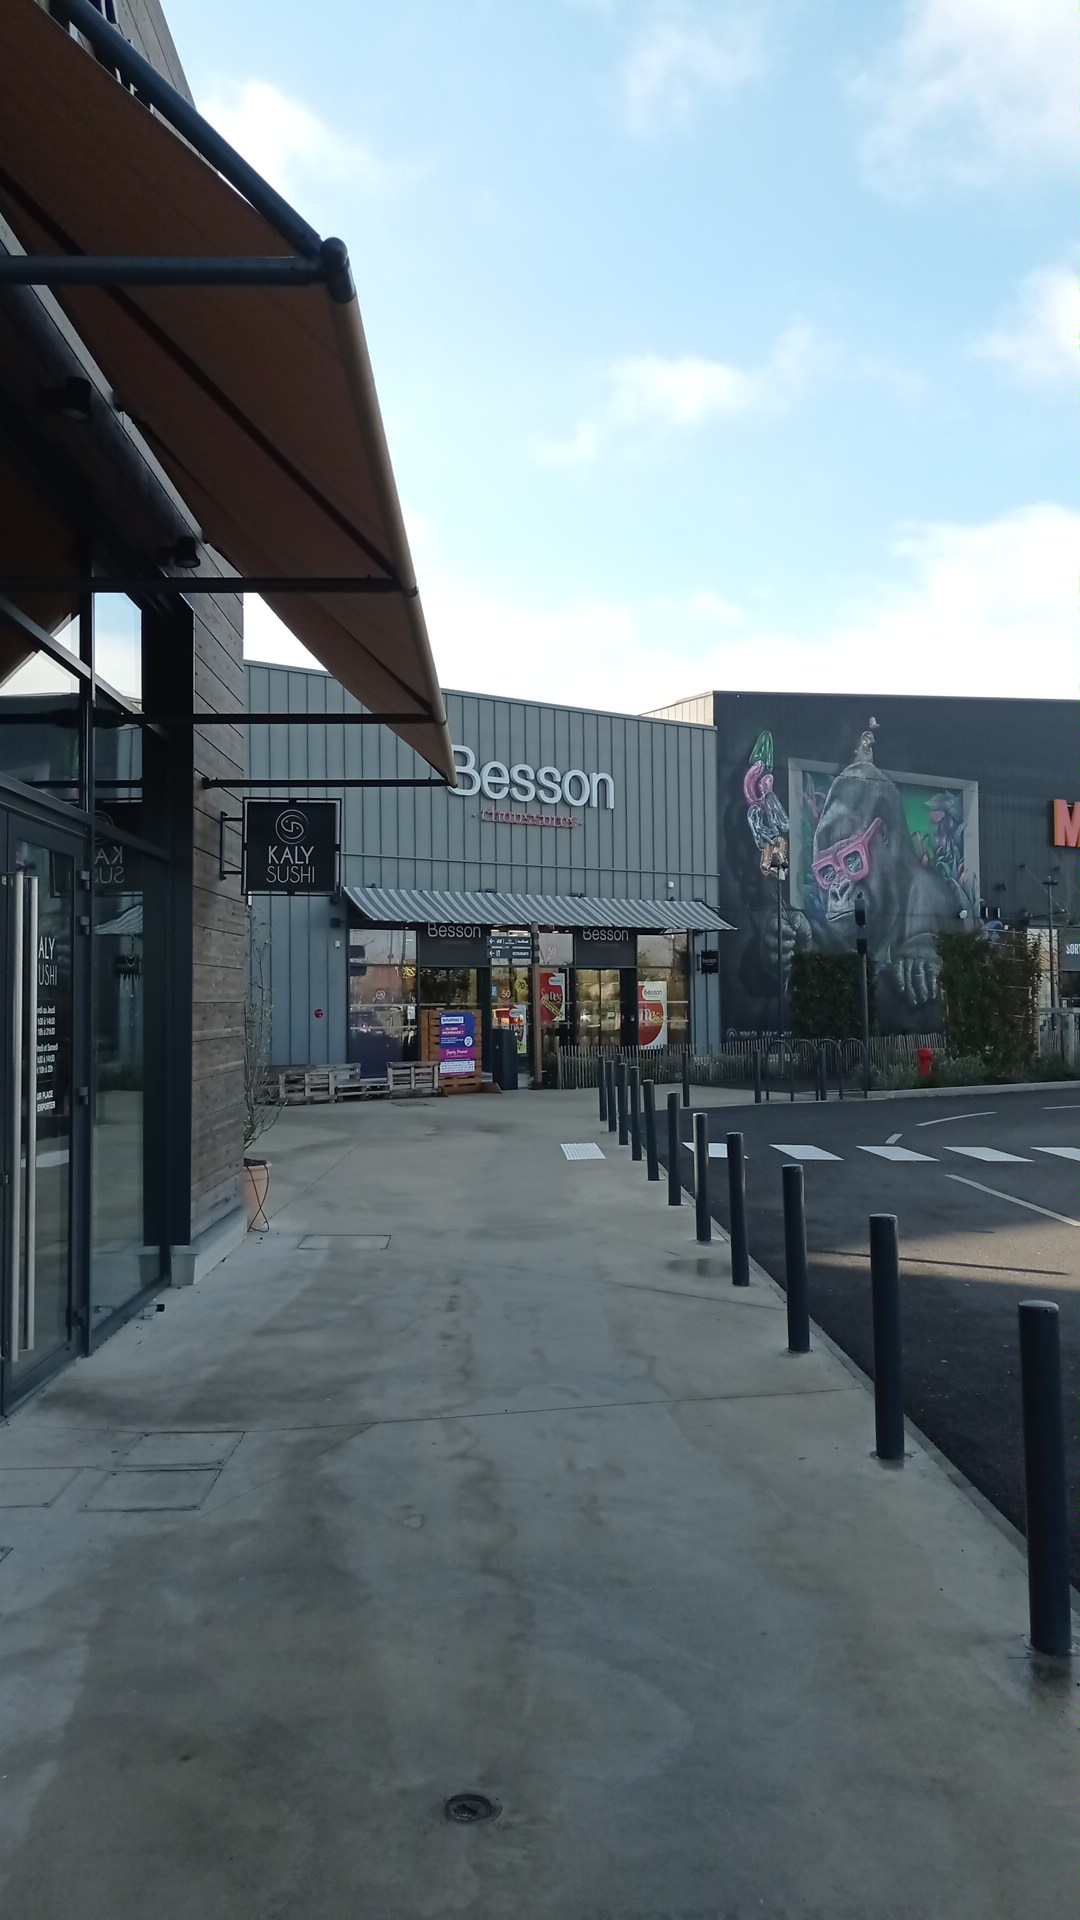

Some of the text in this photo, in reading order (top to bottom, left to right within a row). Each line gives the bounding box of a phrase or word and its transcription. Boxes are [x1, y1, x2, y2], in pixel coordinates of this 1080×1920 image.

[447, 744, 615, 810] Besson
[268, 845, 315, 864] KALY
[266, 865, 315, 883] SUSHI
[427, 922, 481, 938] Besson
[38, 935, 56, 960] ALY
[38, 964, 58, 986] USHI
